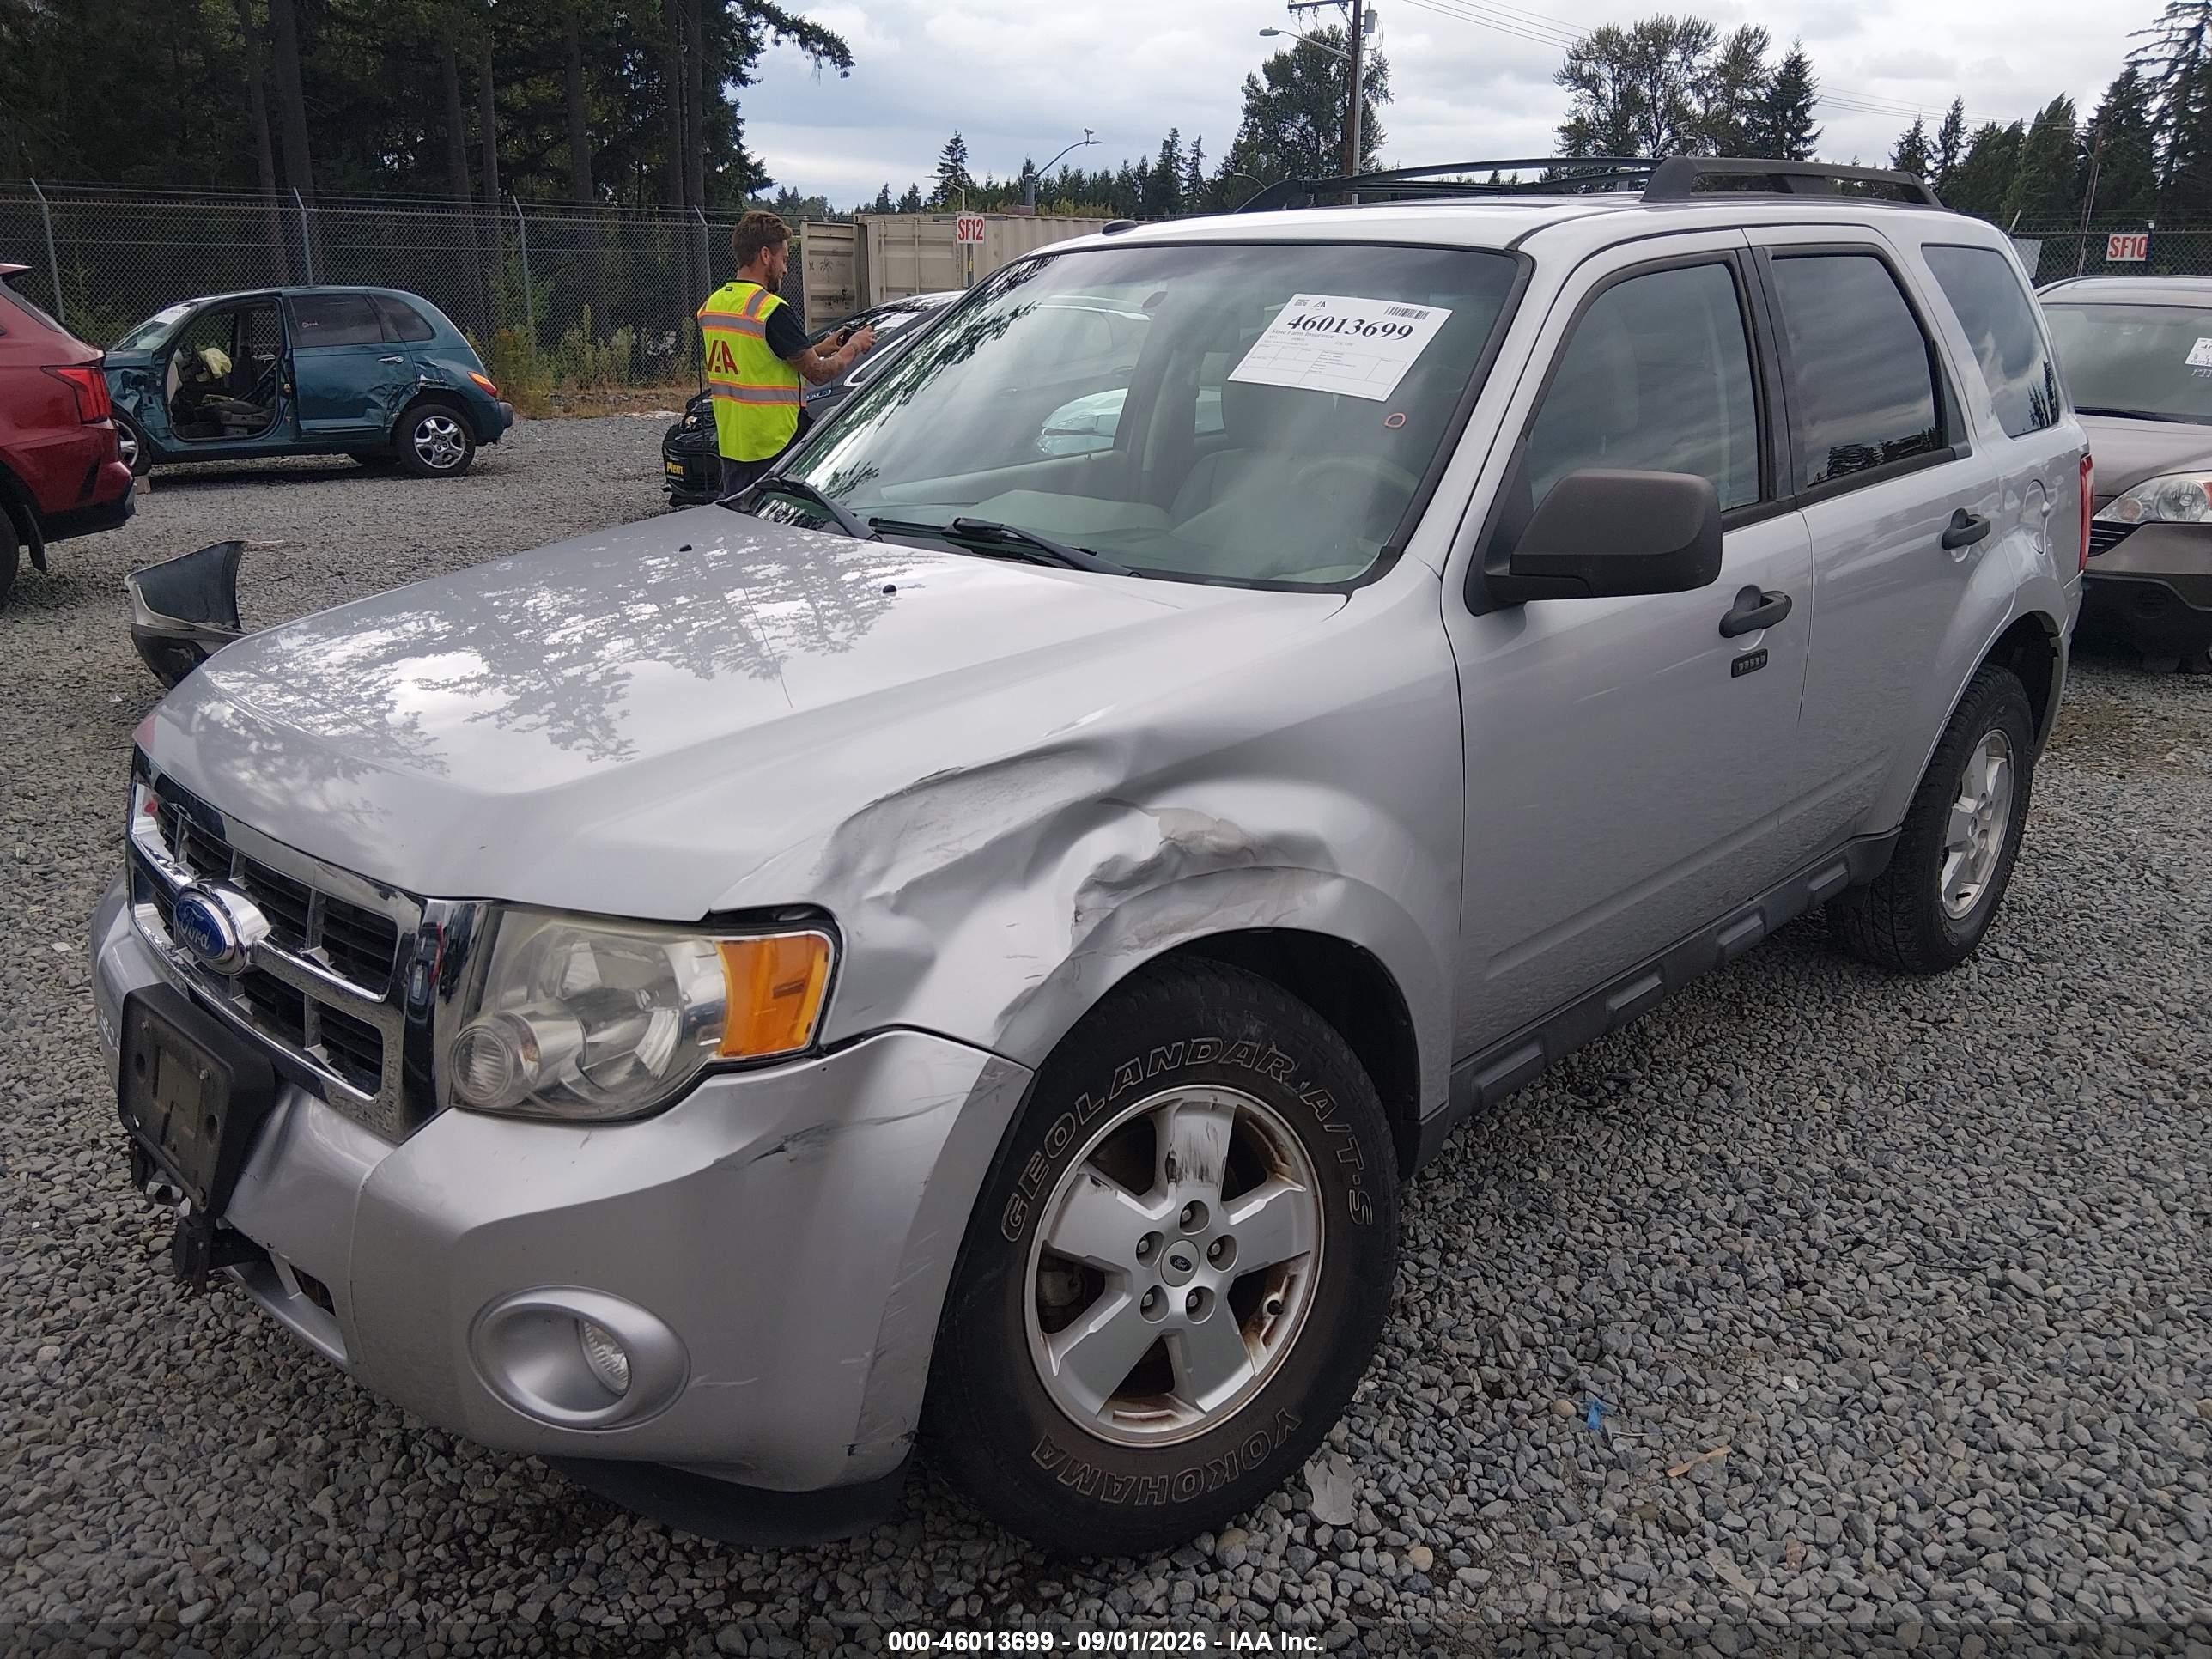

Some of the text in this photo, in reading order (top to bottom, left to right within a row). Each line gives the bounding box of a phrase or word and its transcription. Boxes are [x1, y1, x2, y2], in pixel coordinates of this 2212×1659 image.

[957, 218, 984, 241] SF12
[2109, 236, 2148, 258] SF10
[1287, 314, 1413, 340] 46013699
[181, 905, 211, 950] Ford
[1000, 1037, 1296, 1243] GEOLANDAR
[1031, 1407, 1303, 1505] YOKOHAMA
